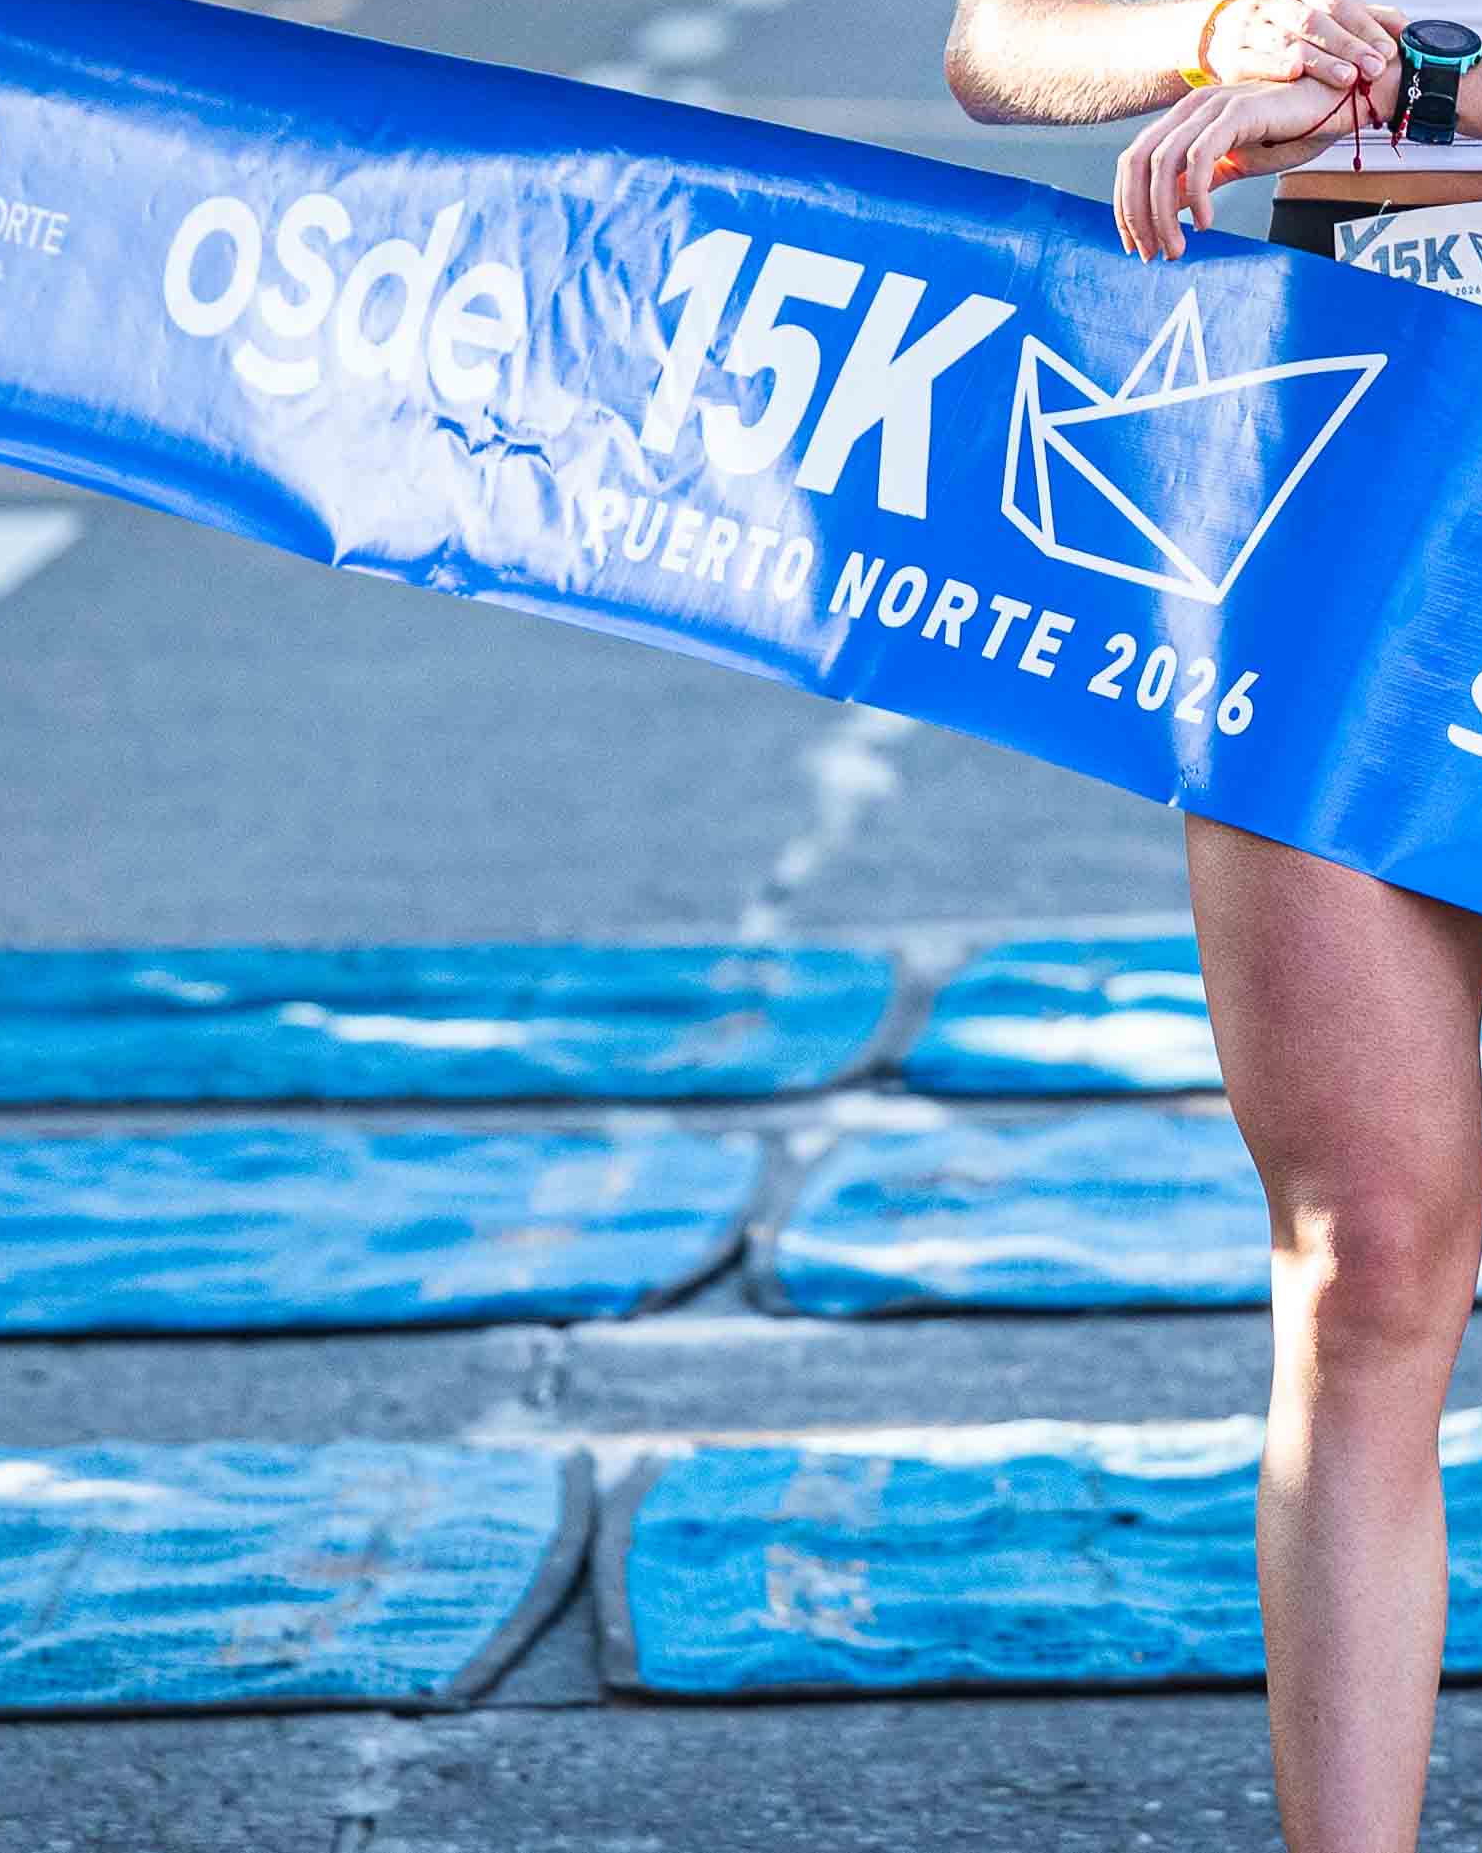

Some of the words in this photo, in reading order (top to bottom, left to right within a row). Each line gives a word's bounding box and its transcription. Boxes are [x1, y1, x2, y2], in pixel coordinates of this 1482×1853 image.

[1371, 233, 1464, 284] 15K
[1454, 285, 1482, 296] 2026
[638, 227, 1018, 520] 15K
[581, 488, 815, 602] PUERTO
[828, 551, 1075, 680] NORTE
[1086, 633, 1261, 736] 2026
